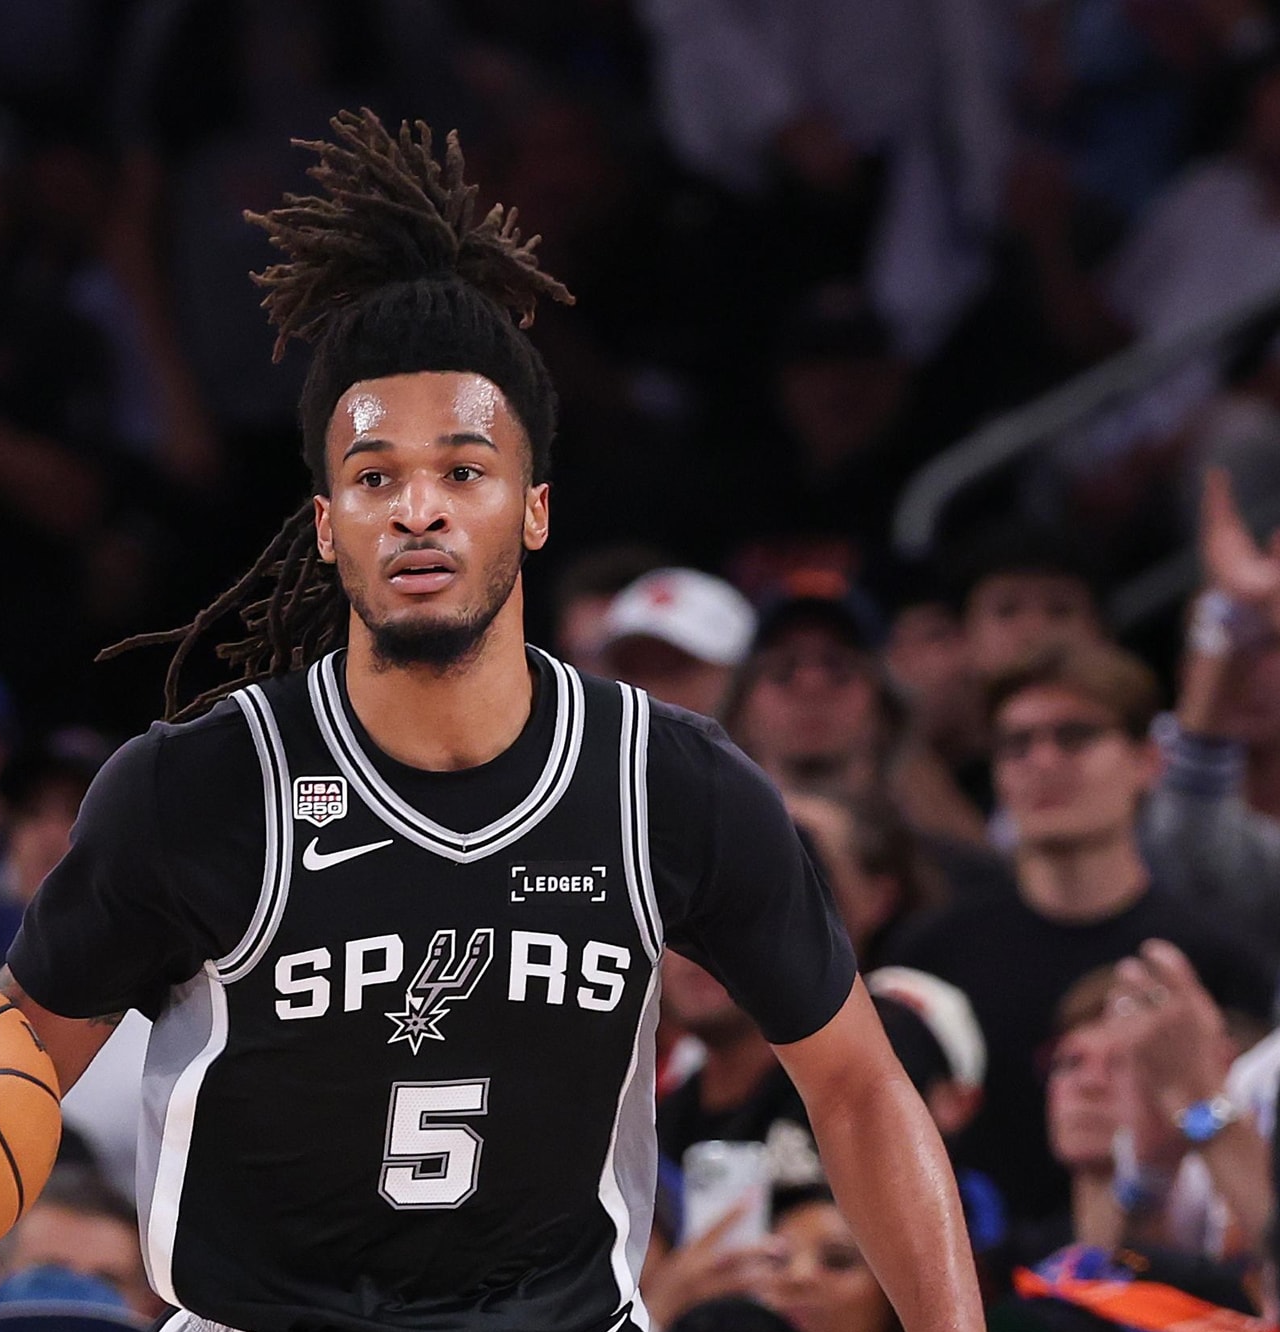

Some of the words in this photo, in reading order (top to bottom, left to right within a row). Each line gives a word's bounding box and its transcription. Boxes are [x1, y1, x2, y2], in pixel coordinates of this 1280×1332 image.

[300, 783, 340, 795] USA
[298, 802, 342, 815] 250
[523, 876, 594, 892] LEDGER
[377, 1077, 491, 1211] 5
